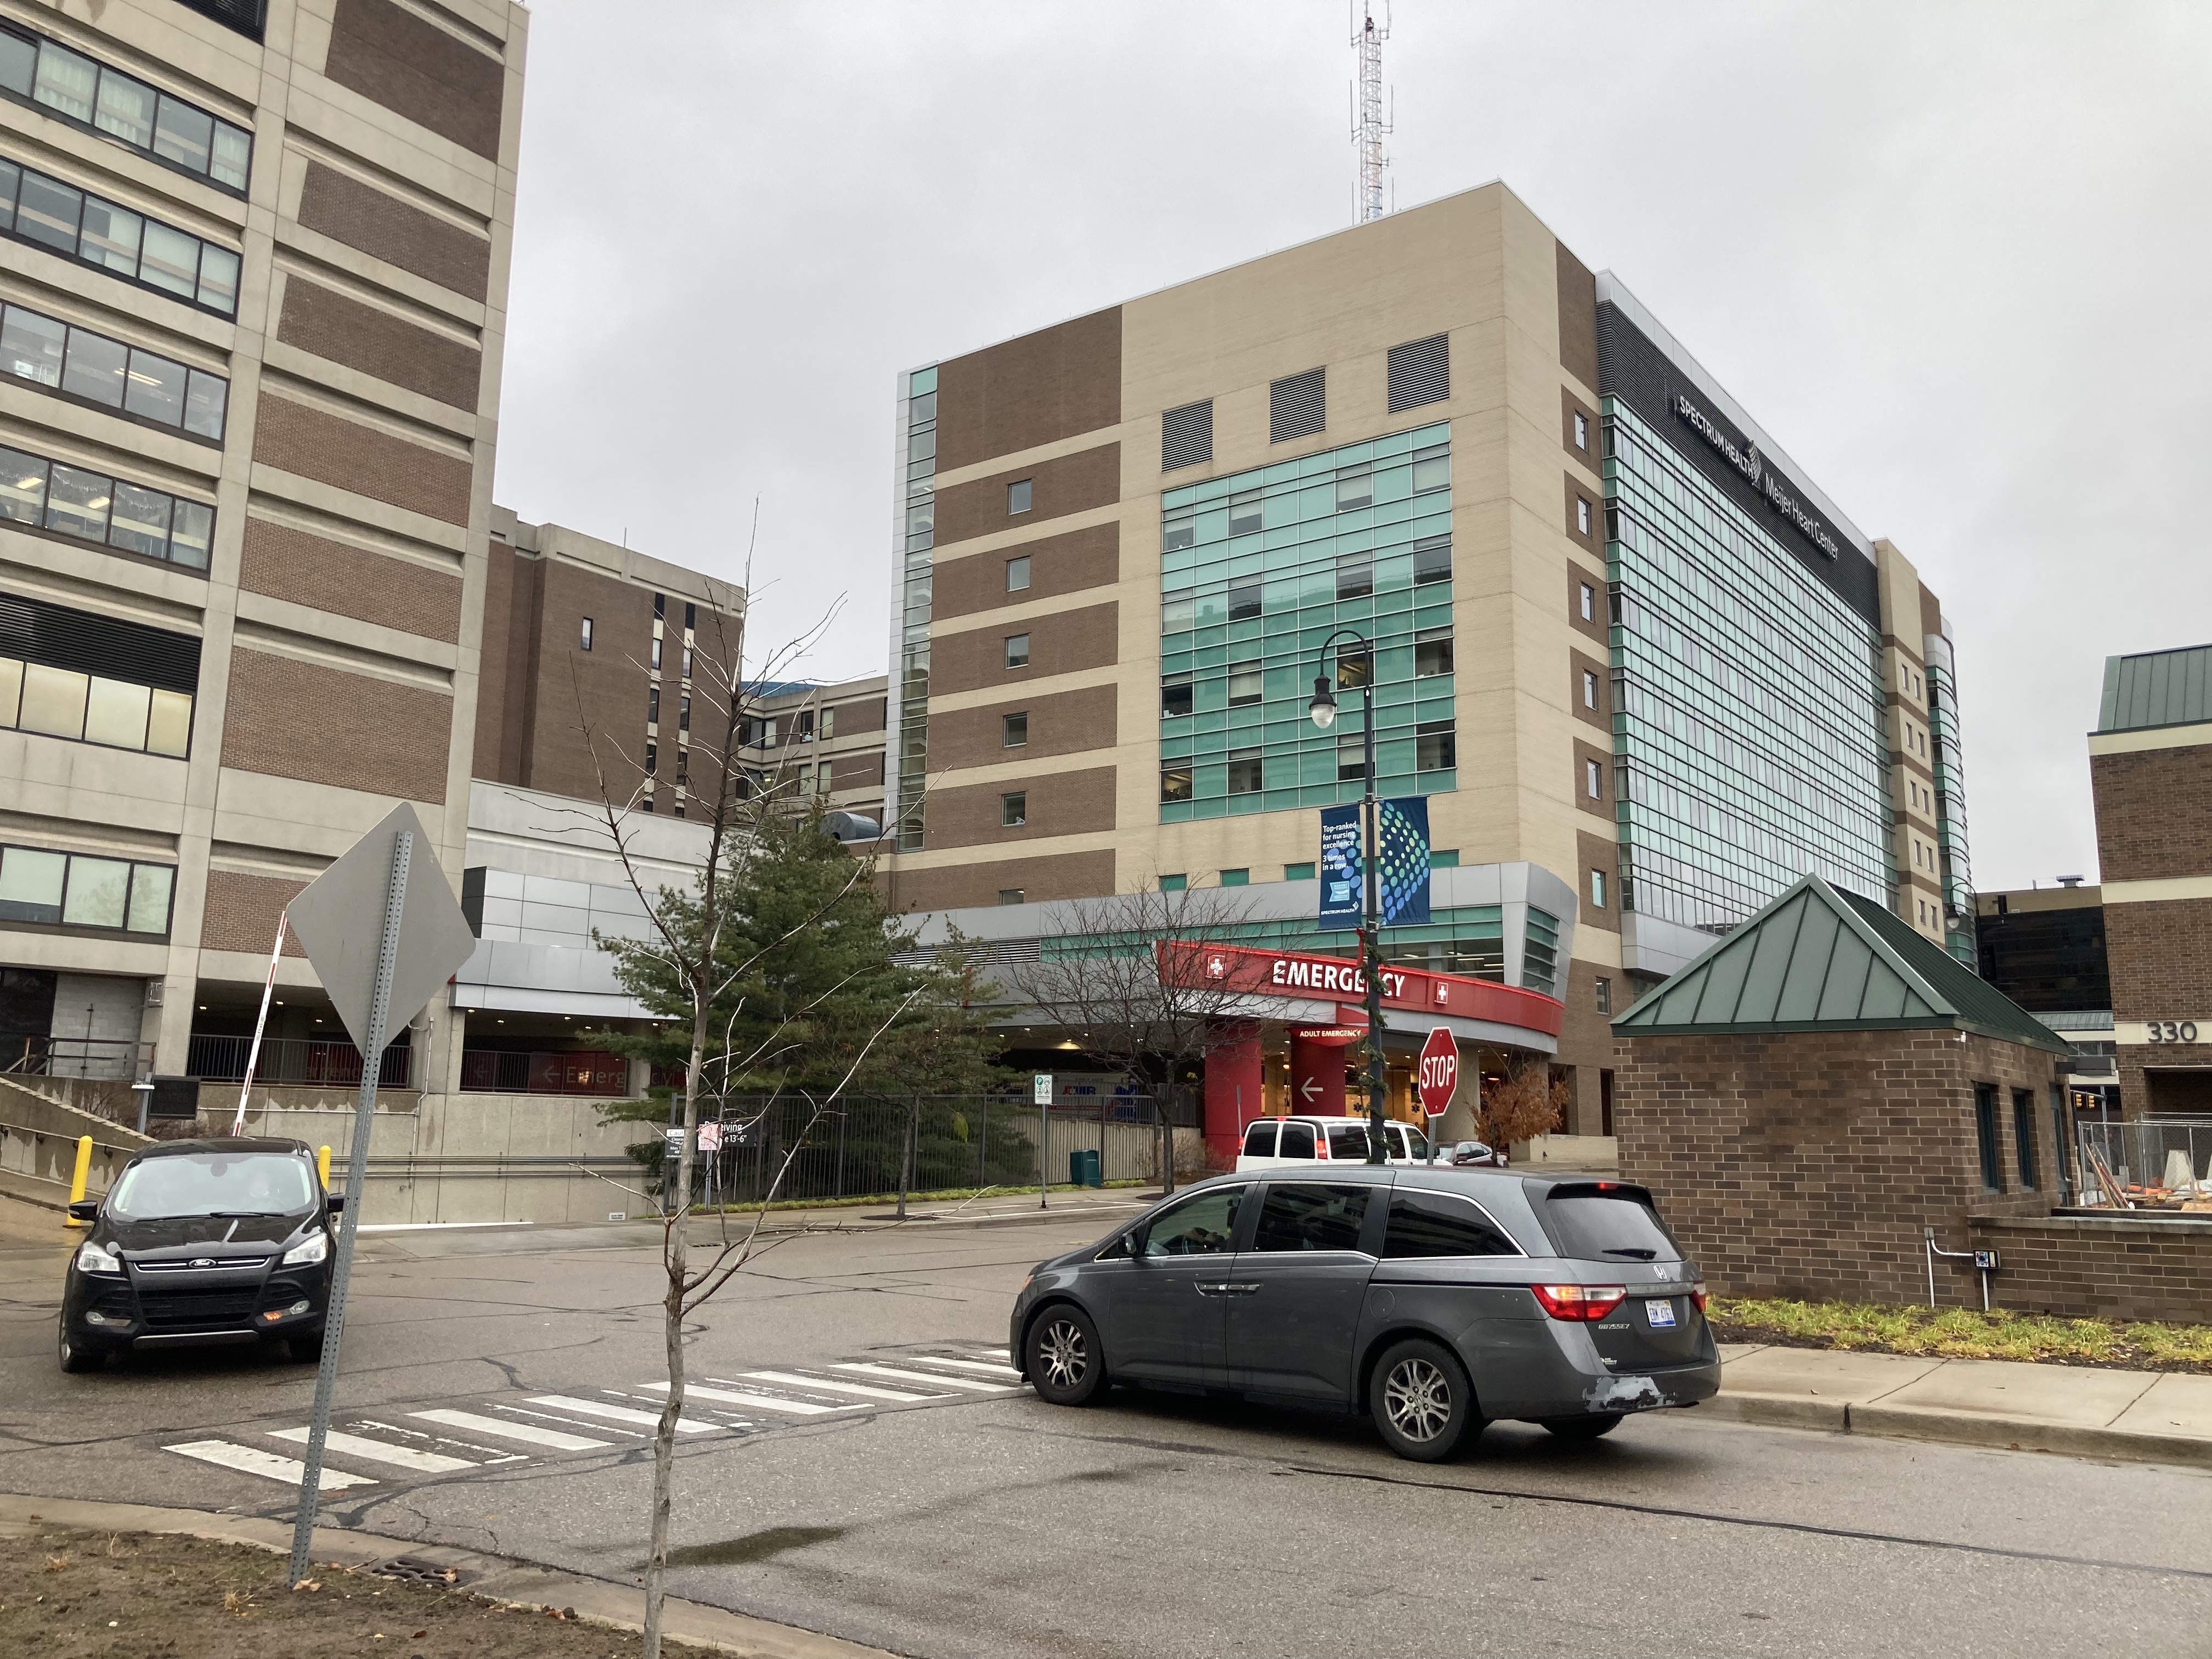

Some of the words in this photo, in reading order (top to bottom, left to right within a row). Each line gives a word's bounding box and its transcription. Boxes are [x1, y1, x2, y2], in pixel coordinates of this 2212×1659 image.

[1680, 396, 1724, 452] SPECTRUM
[1725, 439, 1754, 479] HEALTH
[1765, 472, 1791, 515] Meijer
[1792, 499, 1814, 538] Heart
[1814, 522, 1838, 560] Center
[1323, 820, 1356, 833] Top-ranked
[1333, 831, 1356, 839] nursing
[1323, 840, 1354, 849] excellence
[1273, 960, 1406, 997] EMERGECY
[2147, 1022, 2197, 1042] 330
[1421, 1055, 1455, 1089] STOP
